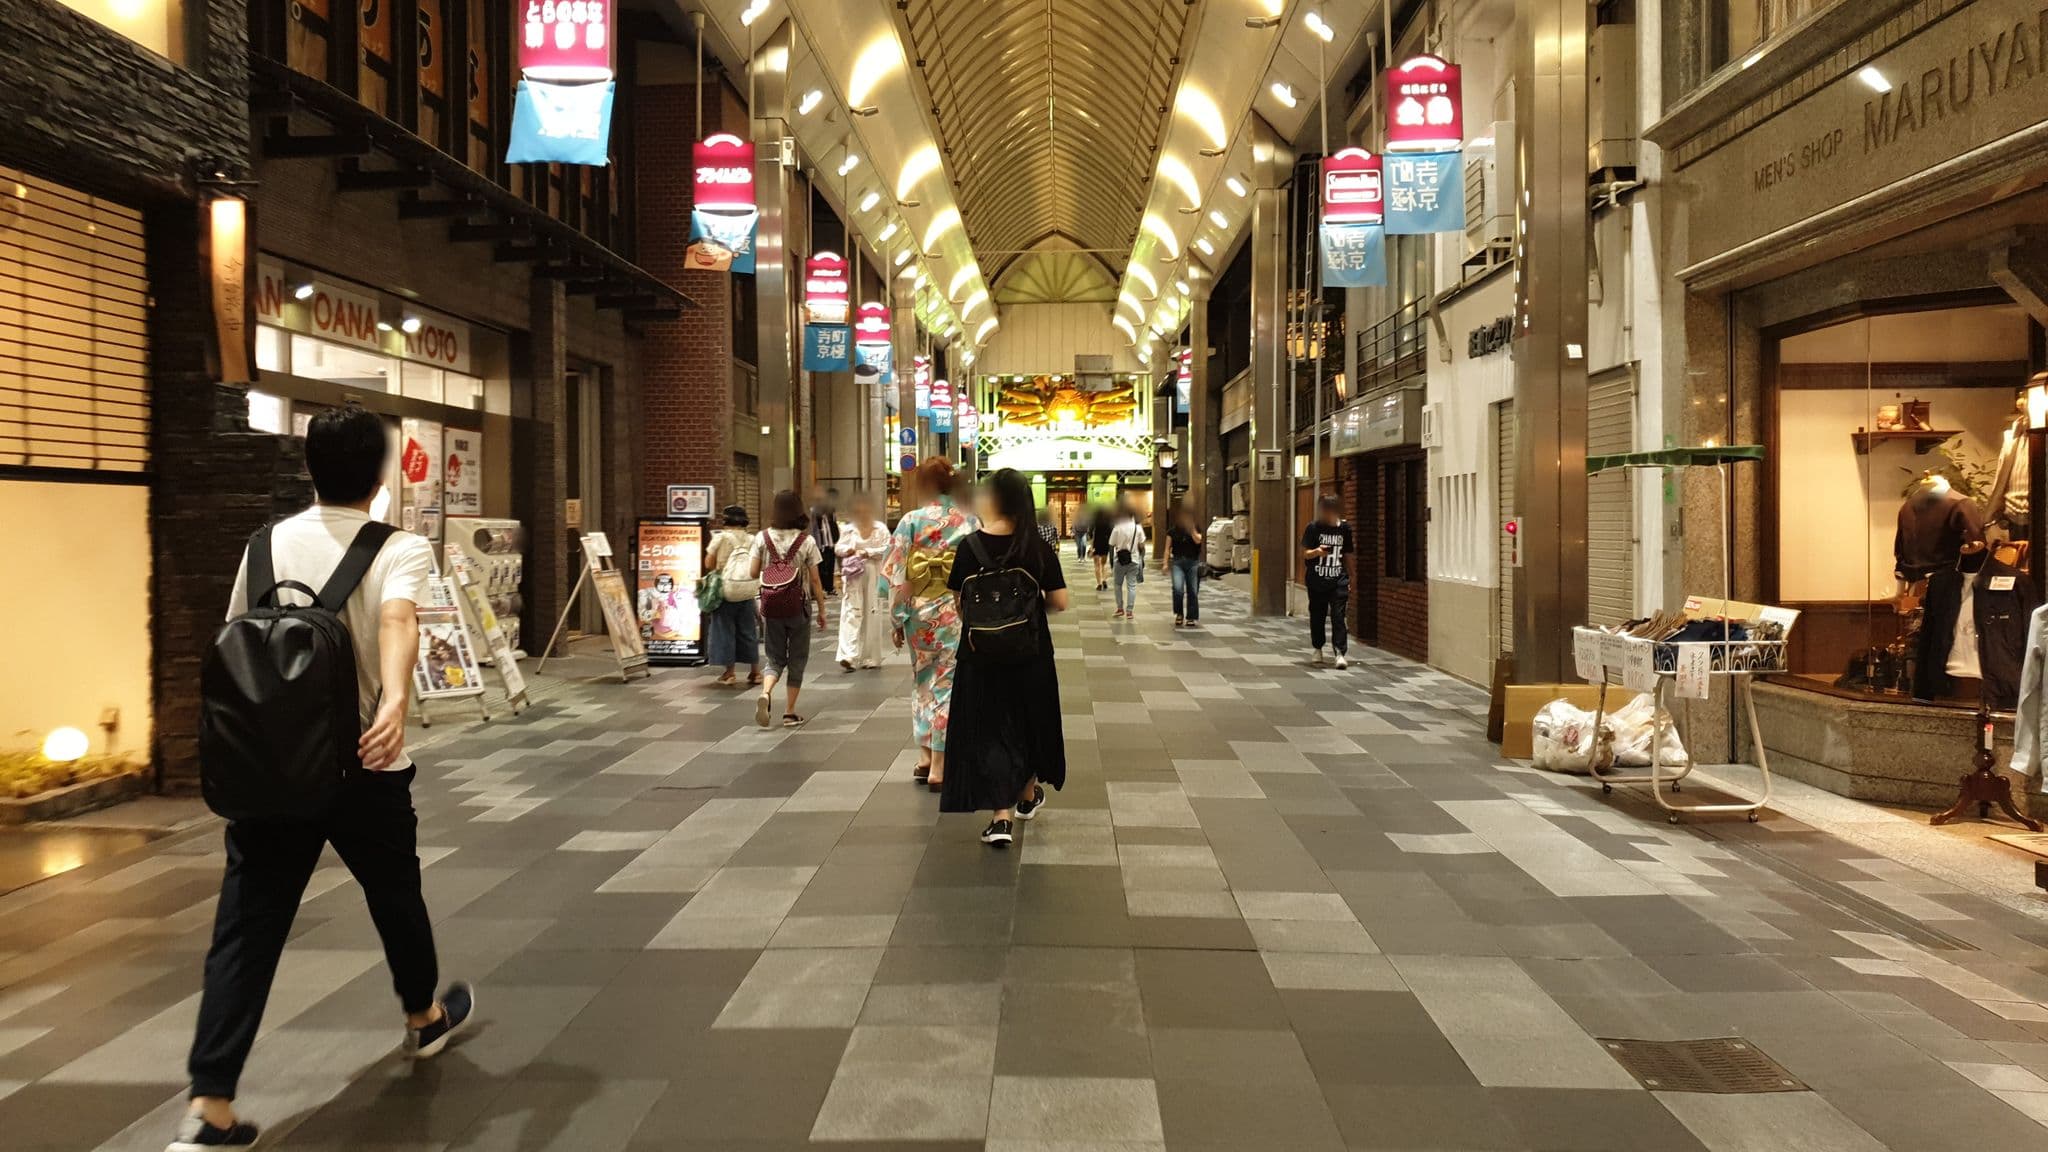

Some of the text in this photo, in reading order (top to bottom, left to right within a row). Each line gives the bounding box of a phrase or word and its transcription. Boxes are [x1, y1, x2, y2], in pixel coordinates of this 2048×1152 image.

[1754, 9, 2048, 192] MEN'S SHOP MARUYA
[314, 291, 377, 343] OANA
